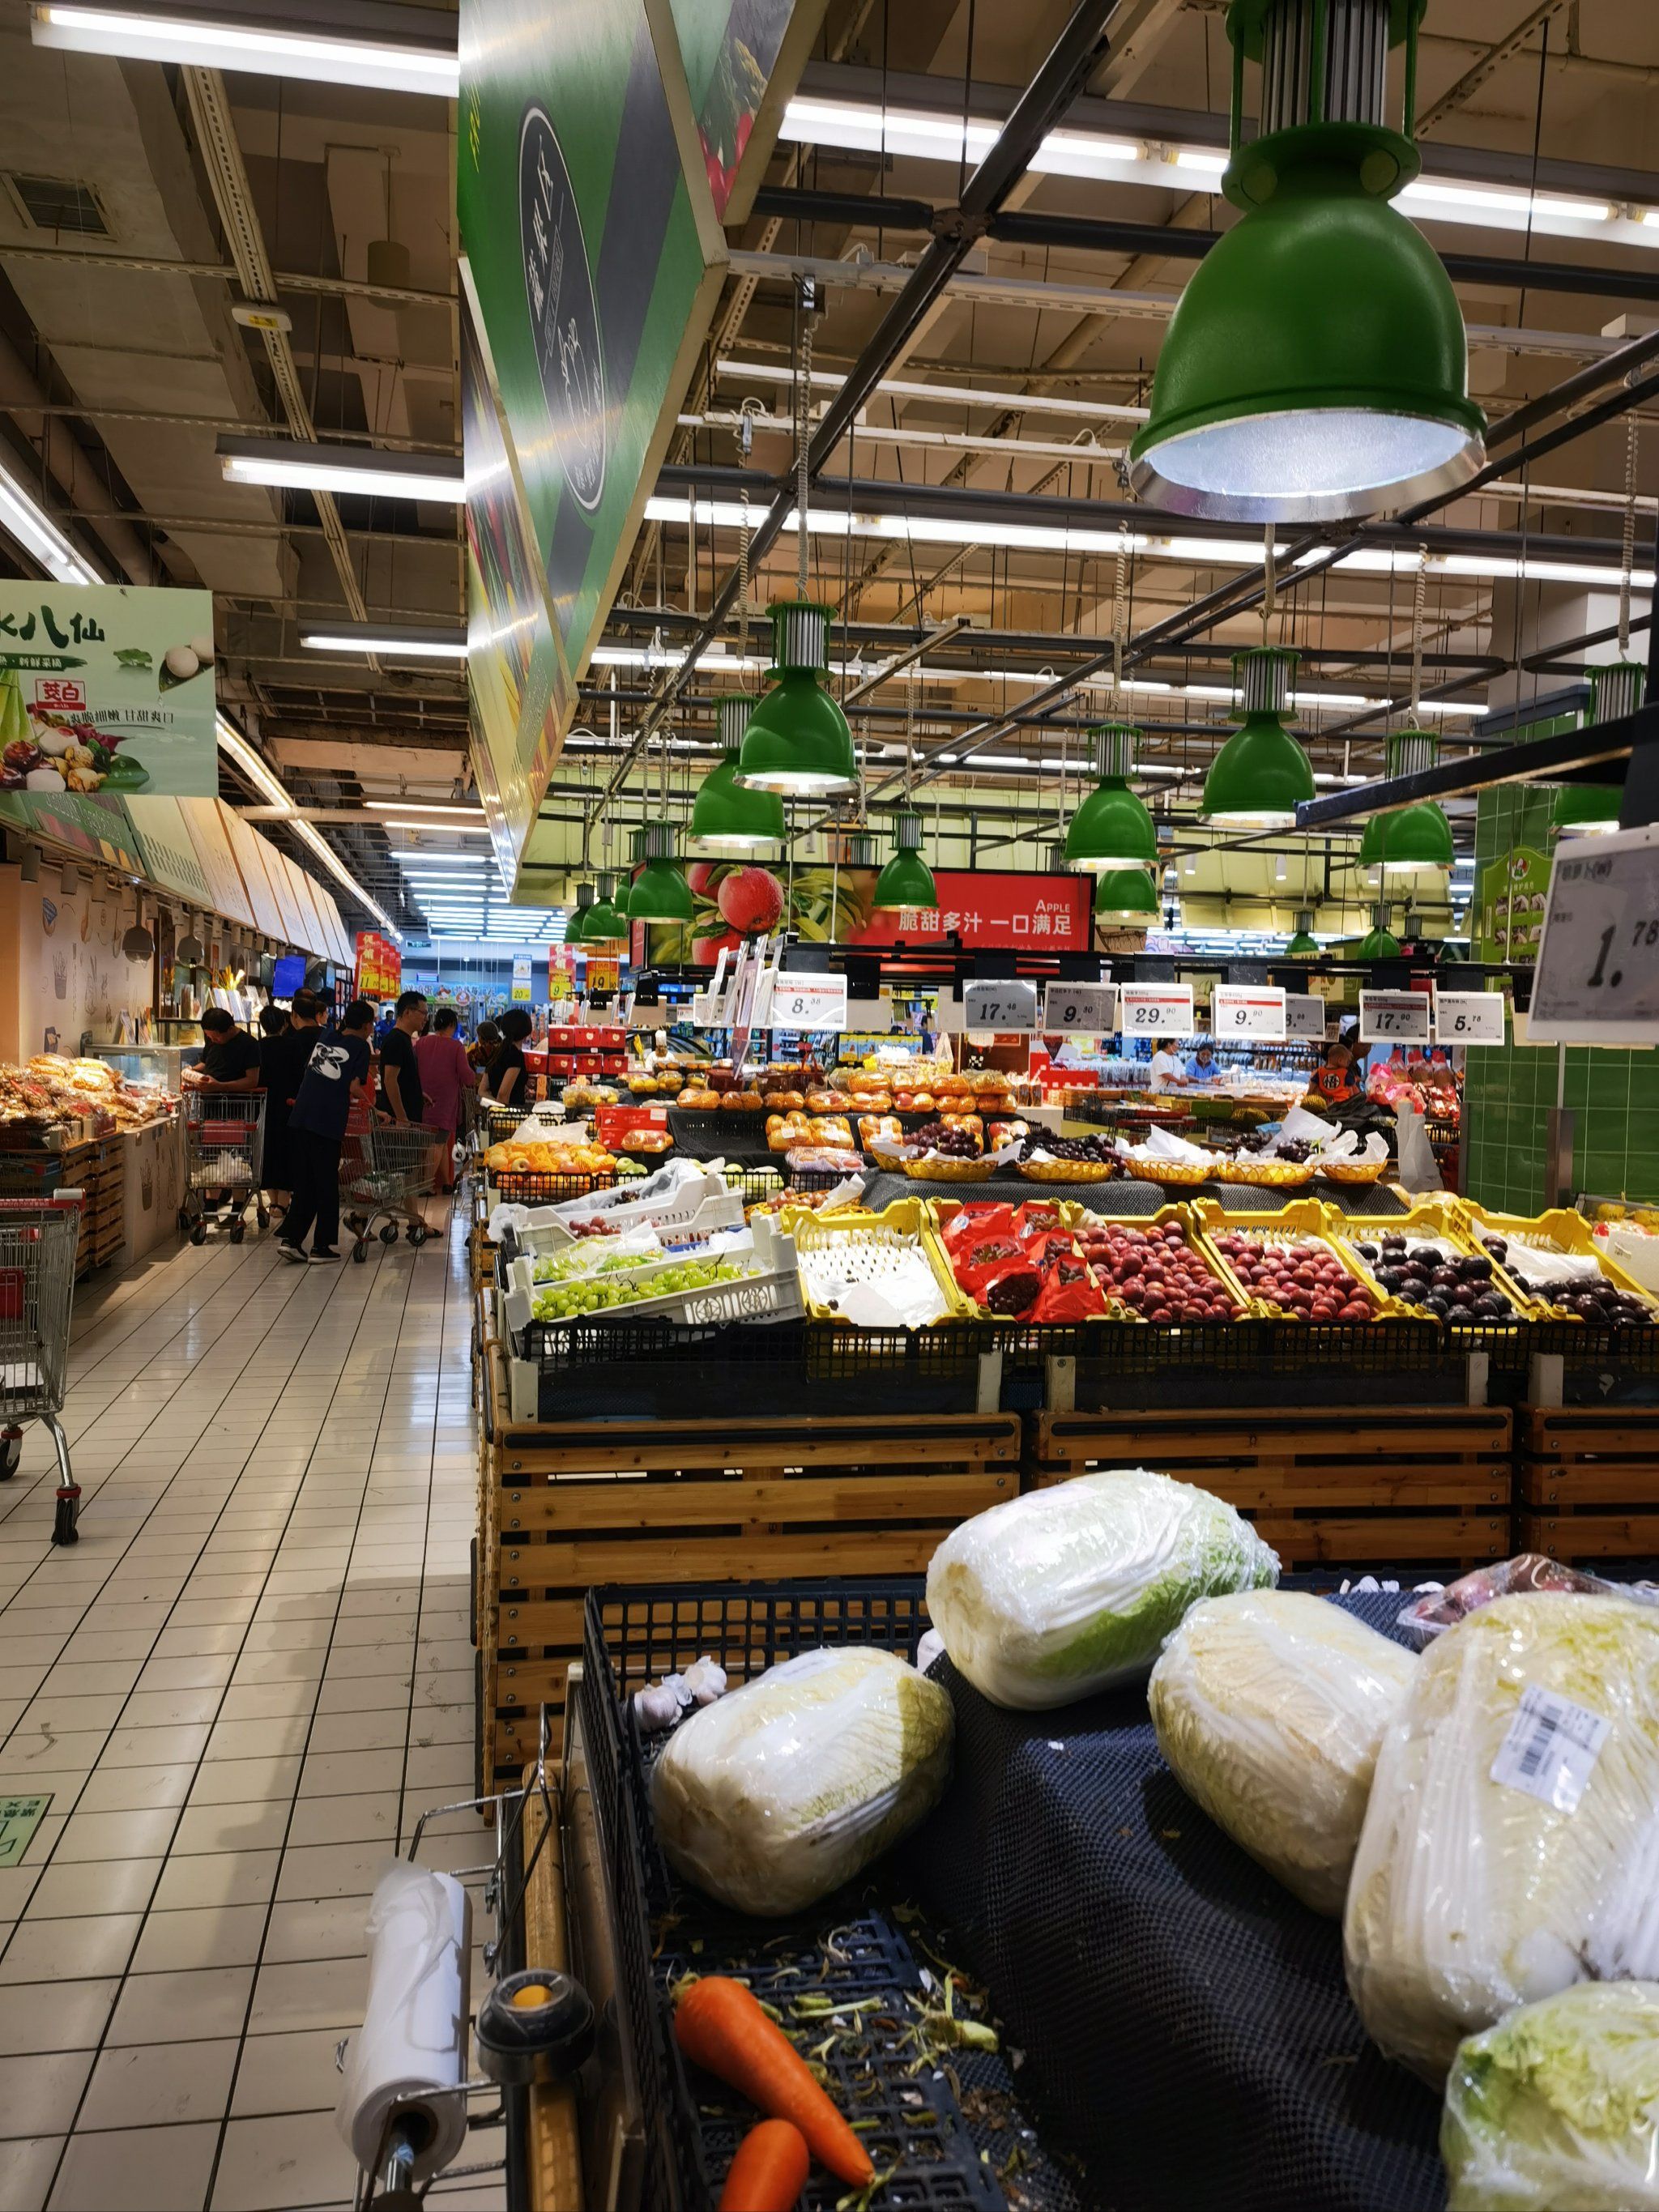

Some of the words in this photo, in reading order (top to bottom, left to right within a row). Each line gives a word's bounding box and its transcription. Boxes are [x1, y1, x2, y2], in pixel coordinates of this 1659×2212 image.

[898, 910, 983, 933] 脆甜多汁
[990, 914, 1073, 936] 一口满足
